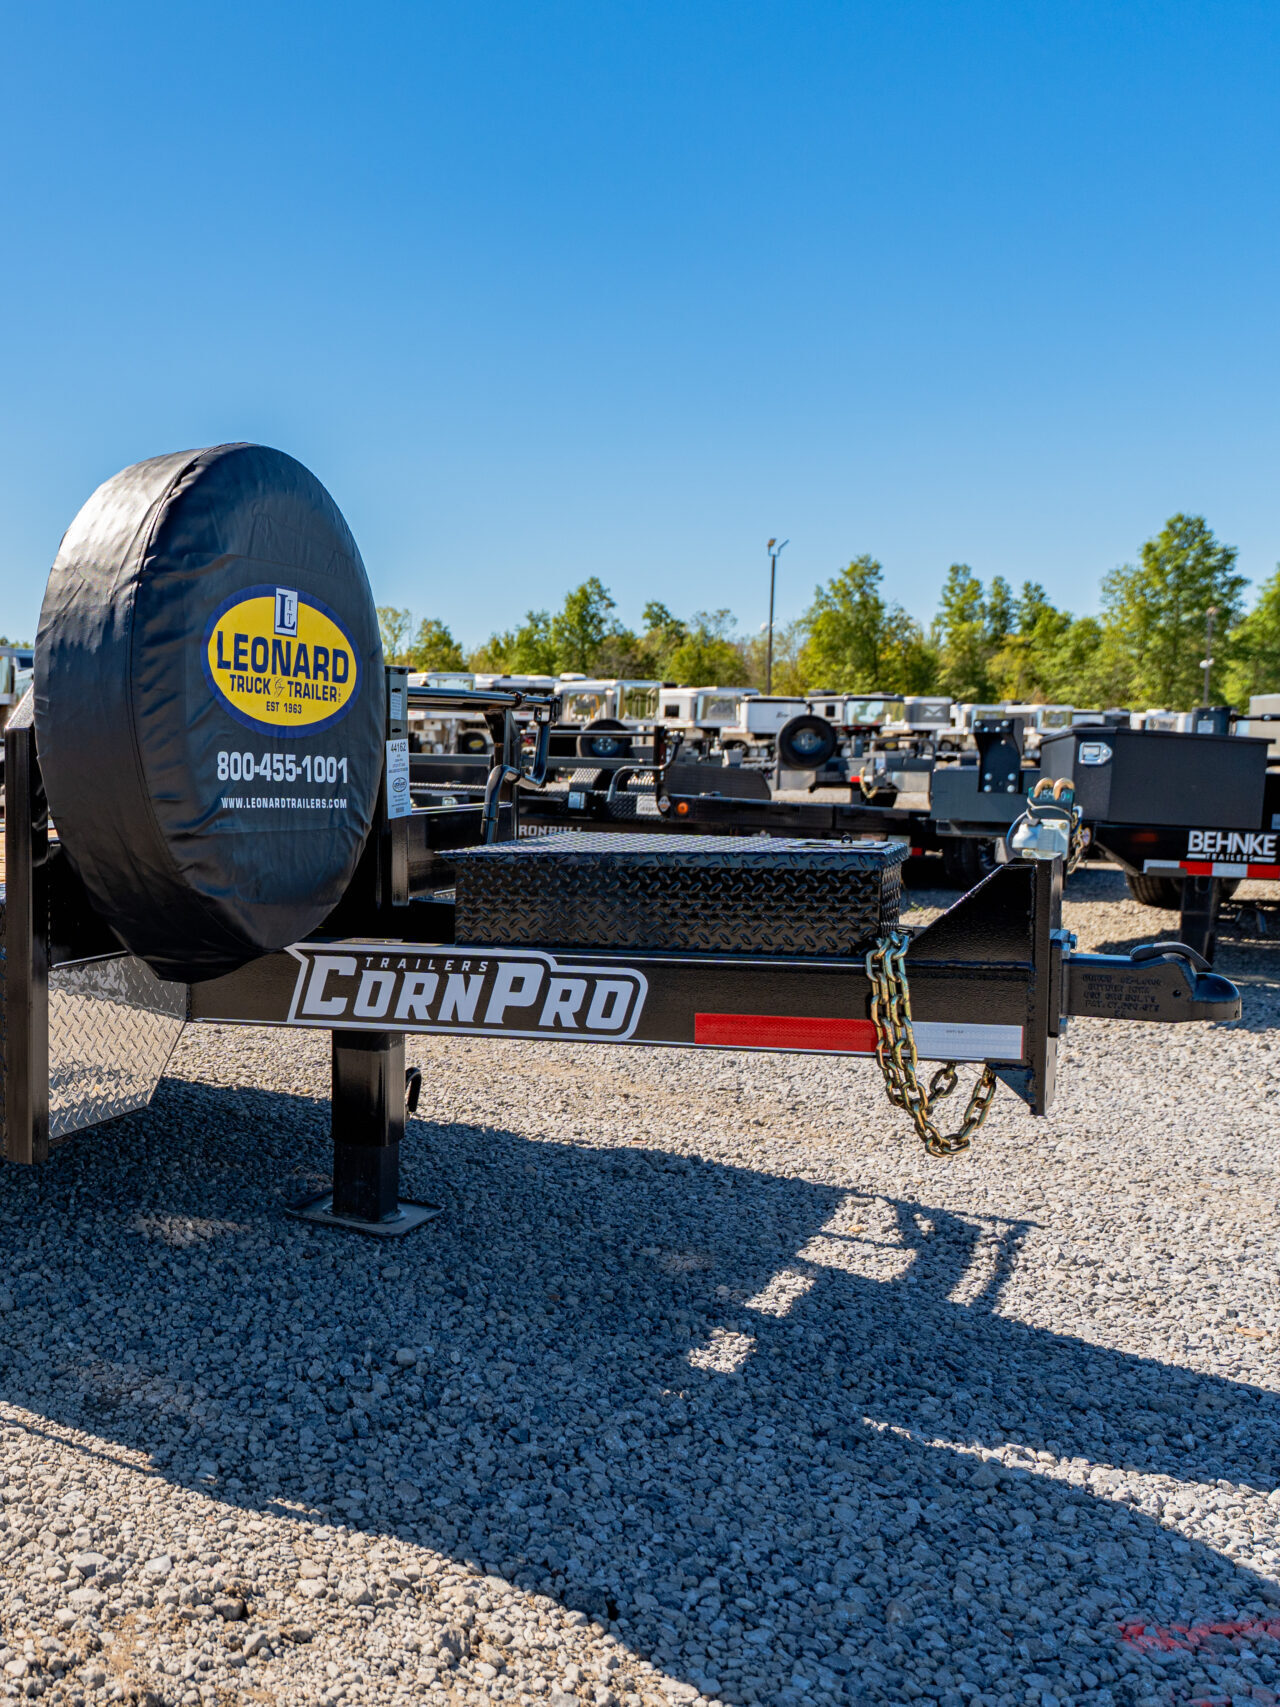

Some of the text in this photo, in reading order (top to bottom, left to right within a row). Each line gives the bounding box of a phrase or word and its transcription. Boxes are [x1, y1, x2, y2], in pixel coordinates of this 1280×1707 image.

[217, 631, 349, 684] LEONARD
[229, 674, 271, 695] TRUCK
[287, 680, 337, 702] TRAILER
[266, 701, 302, 714] EST 1963
[217, 751, 348, 784] 800-455-1001
[221, 797, 347, 809] WWW.LEONARDTRAILERS.COM
[1187, 830, 1278, 857] BEHNKE
[1206, 853, 1254, 862] TRAILERS
[366, 957, 488, 973] TRAILERS
[302, 955, 634, 1030] CORNPRO
